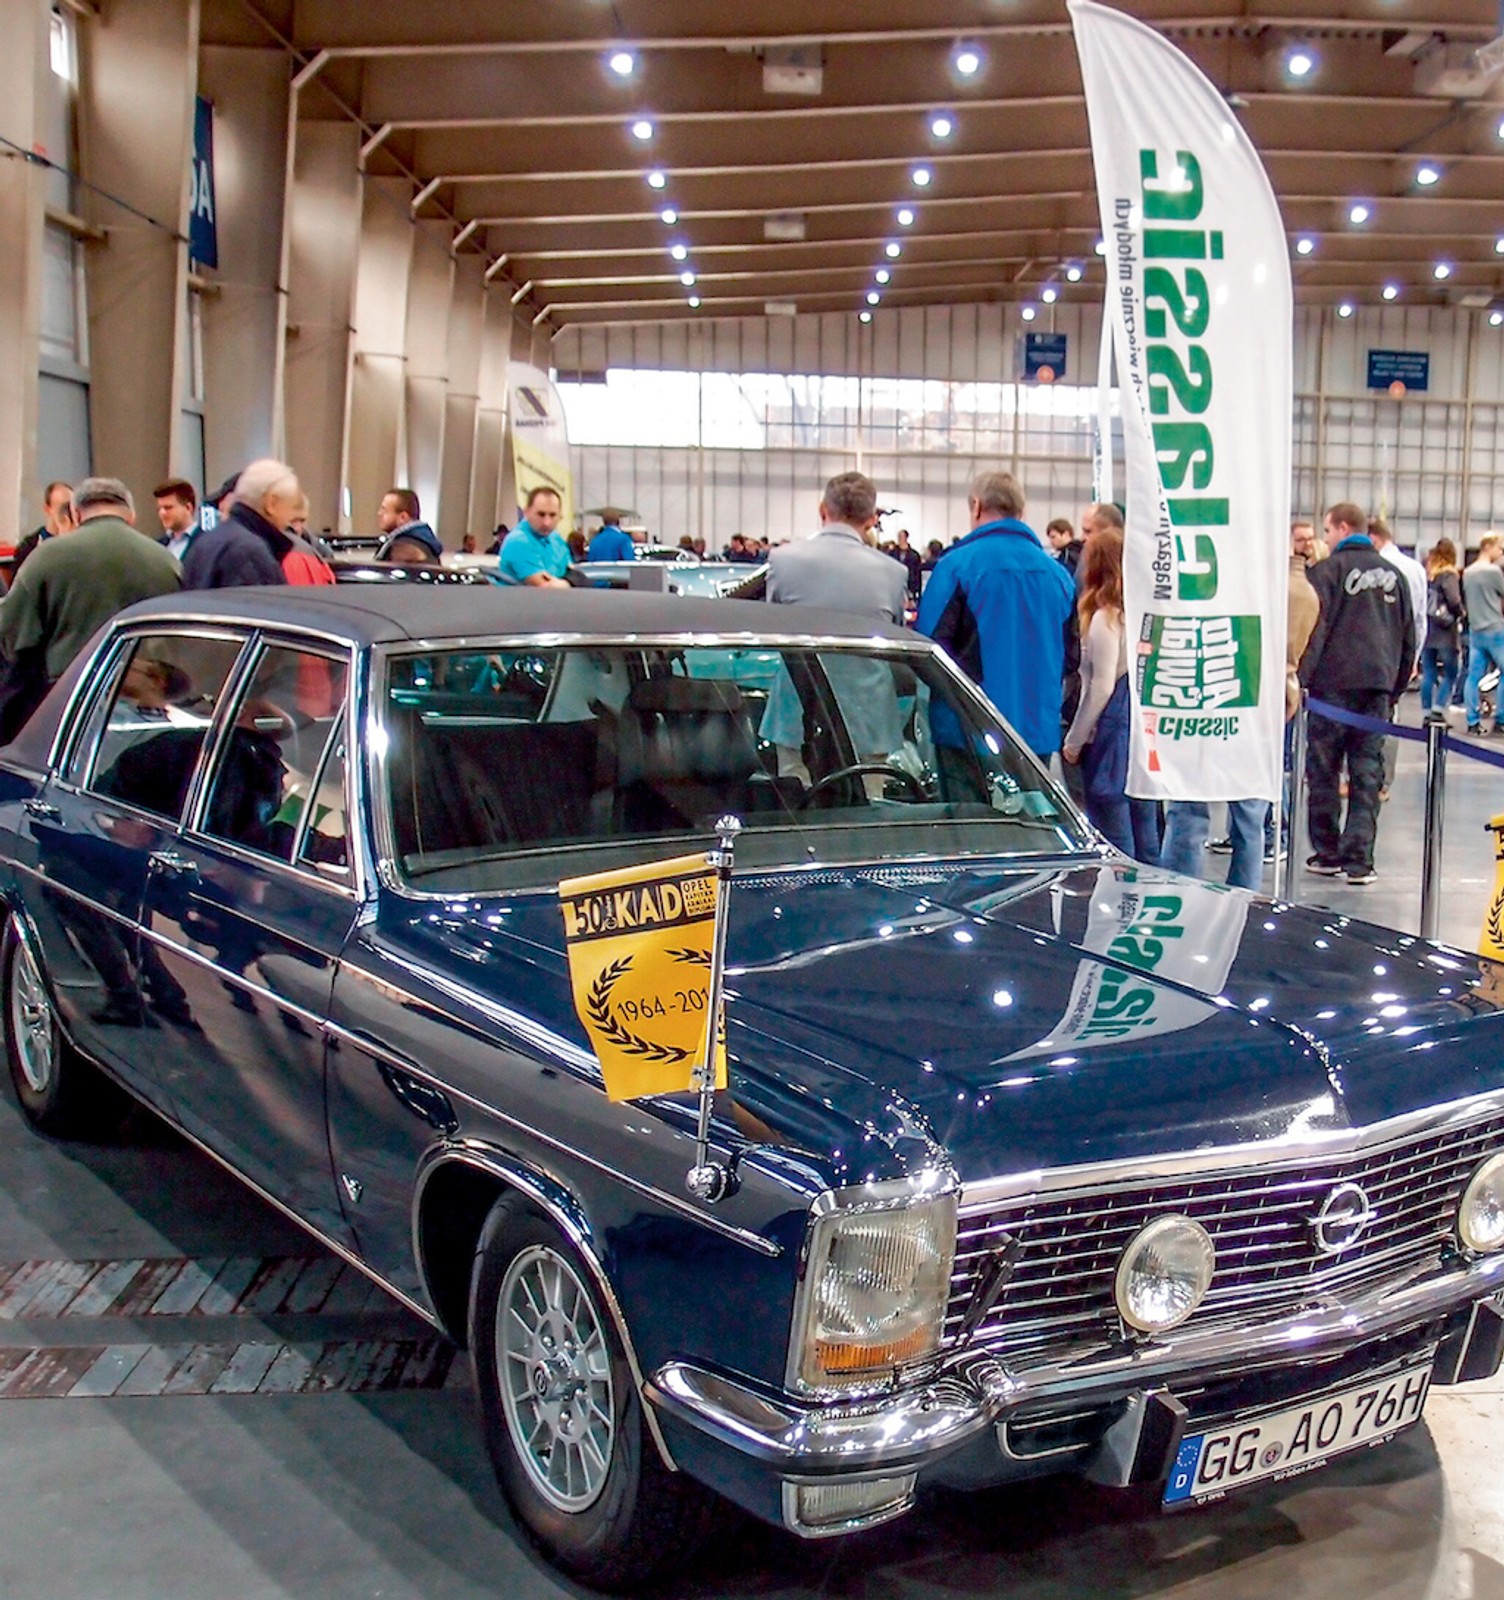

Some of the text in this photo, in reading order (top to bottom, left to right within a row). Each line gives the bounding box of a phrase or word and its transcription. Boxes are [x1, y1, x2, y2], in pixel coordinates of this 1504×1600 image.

[683, 879, 712, 893] OPEL
[1198, 1372, 1428, 1484] GG AO 76H
[1175, 1473, 1188, 1489] D
